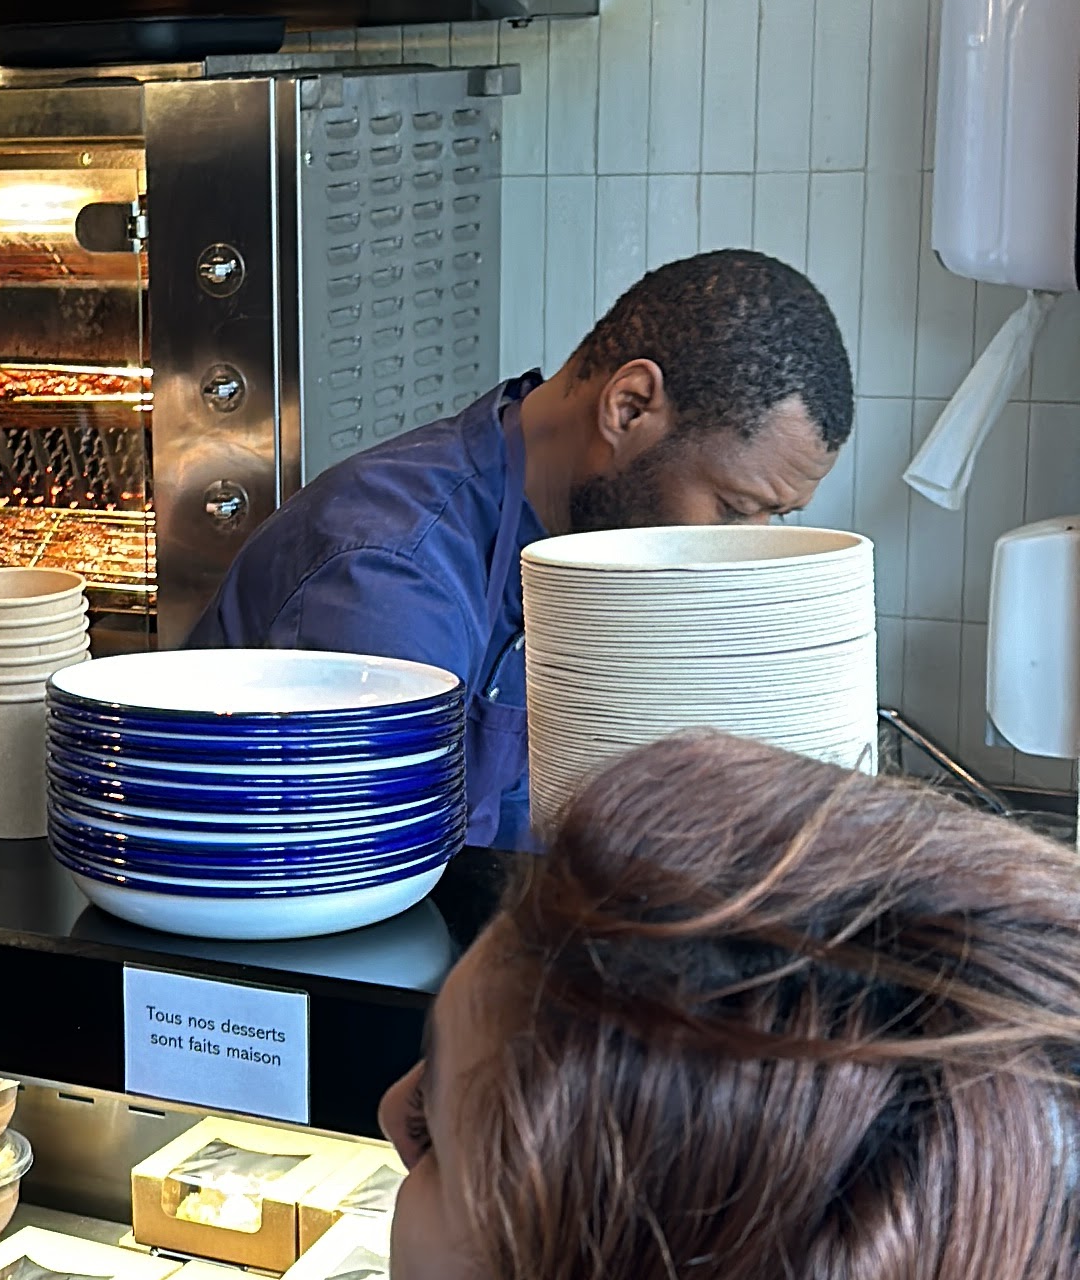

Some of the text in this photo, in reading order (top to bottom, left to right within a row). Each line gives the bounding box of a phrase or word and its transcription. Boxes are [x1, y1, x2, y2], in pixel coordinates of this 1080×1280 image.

[146, 1004, 286, 1043] Tous nos desserts
[150, 1032, 281, 1066] sont faits maison
